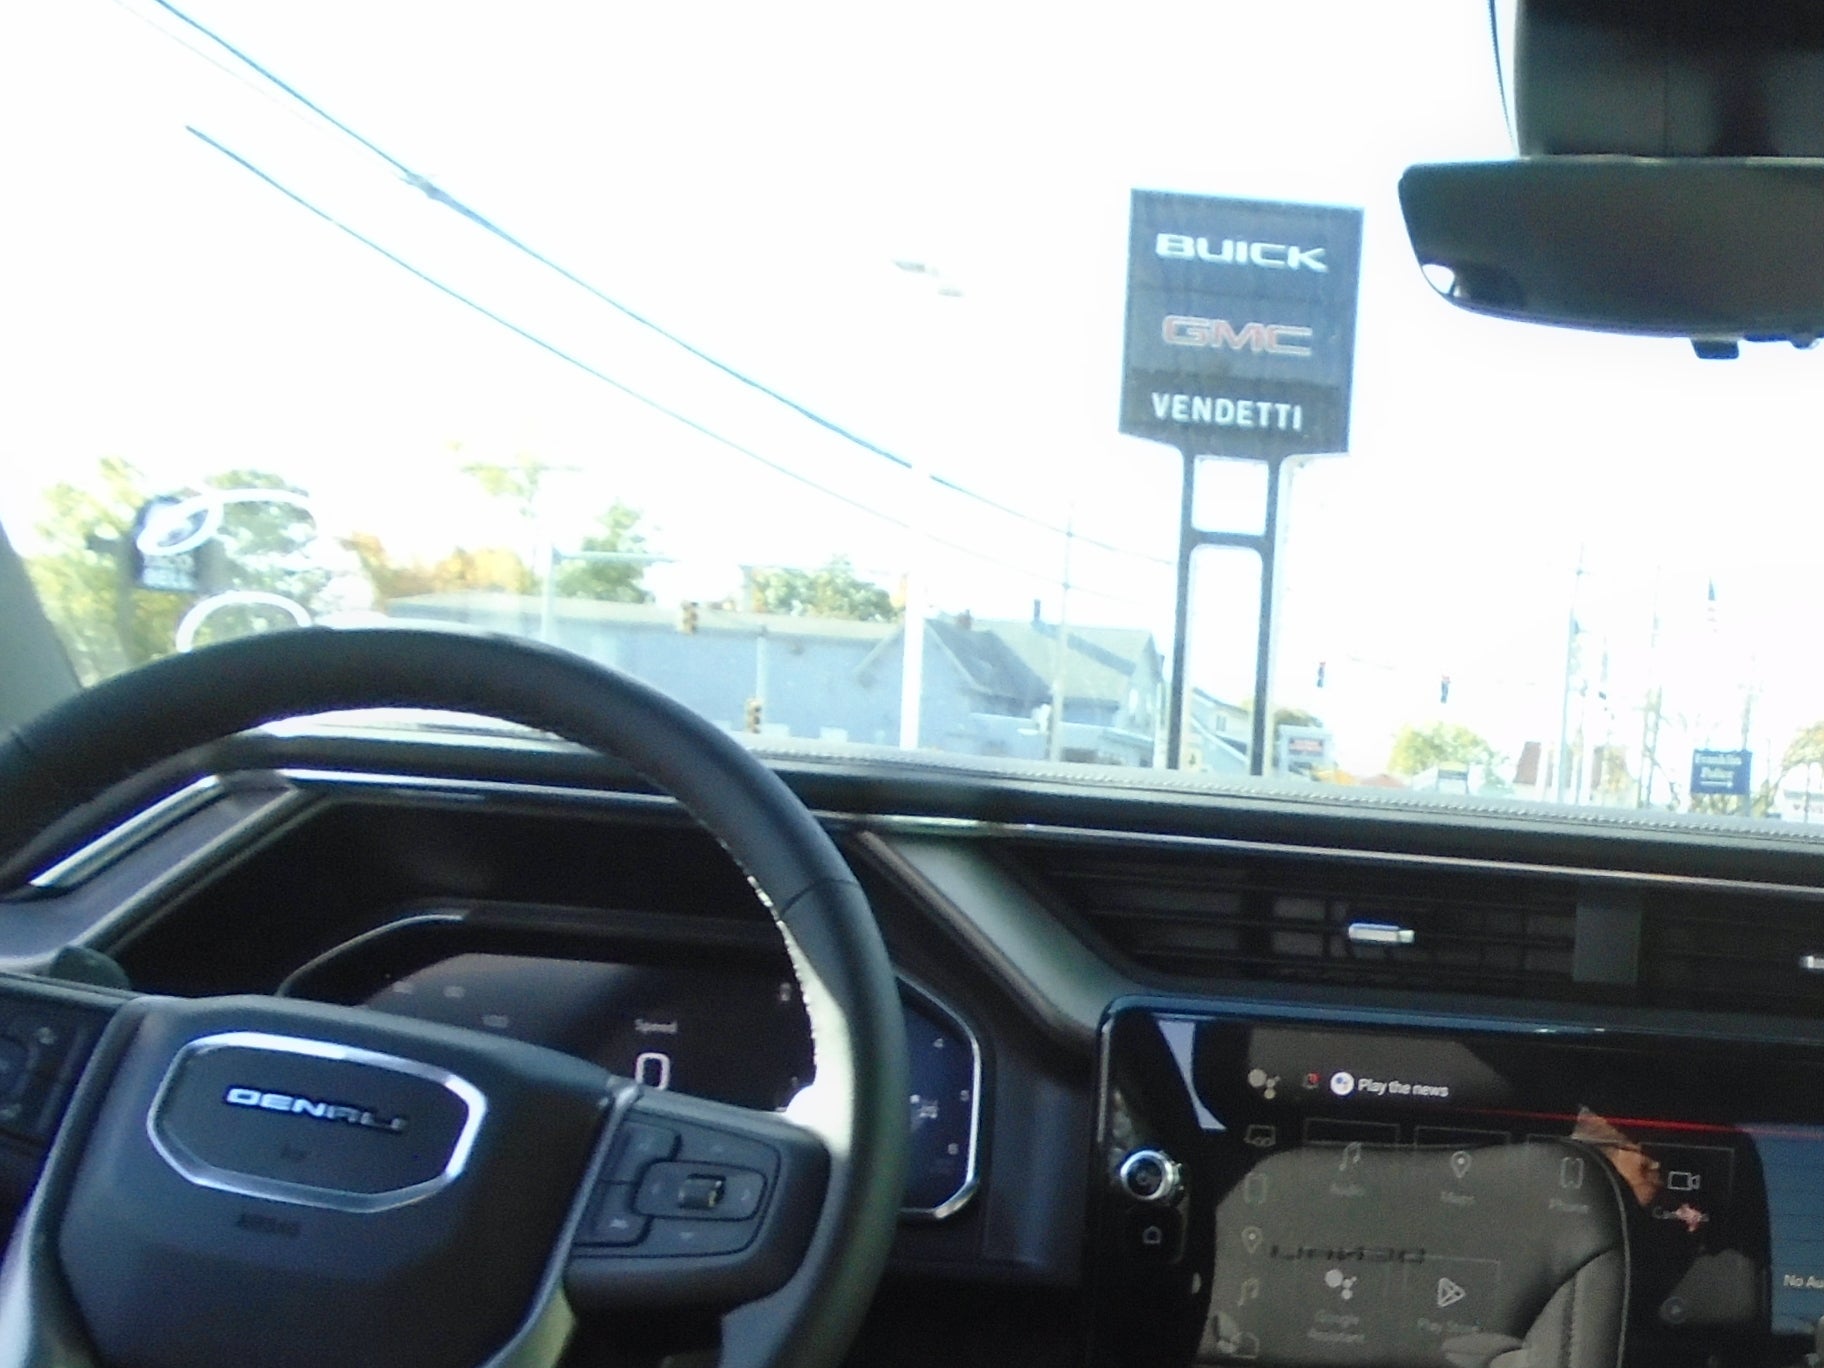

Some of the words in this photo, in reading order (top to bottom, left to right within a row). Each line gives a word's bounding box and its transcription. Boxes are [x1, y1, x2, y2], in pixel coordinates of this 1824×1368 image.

[1155, 232, 1329, 273] BUICK
[1162, 314, 1313, 356] GMC
[1151, 391, 1303, 431] VENDETTI
[1358, 1078, 1387, 1095] Play
[1388, 1080, 1411, 1094] the
[1412, 1085, 1449, 1097] news
[1783, 1274, 1803, 1287] No
